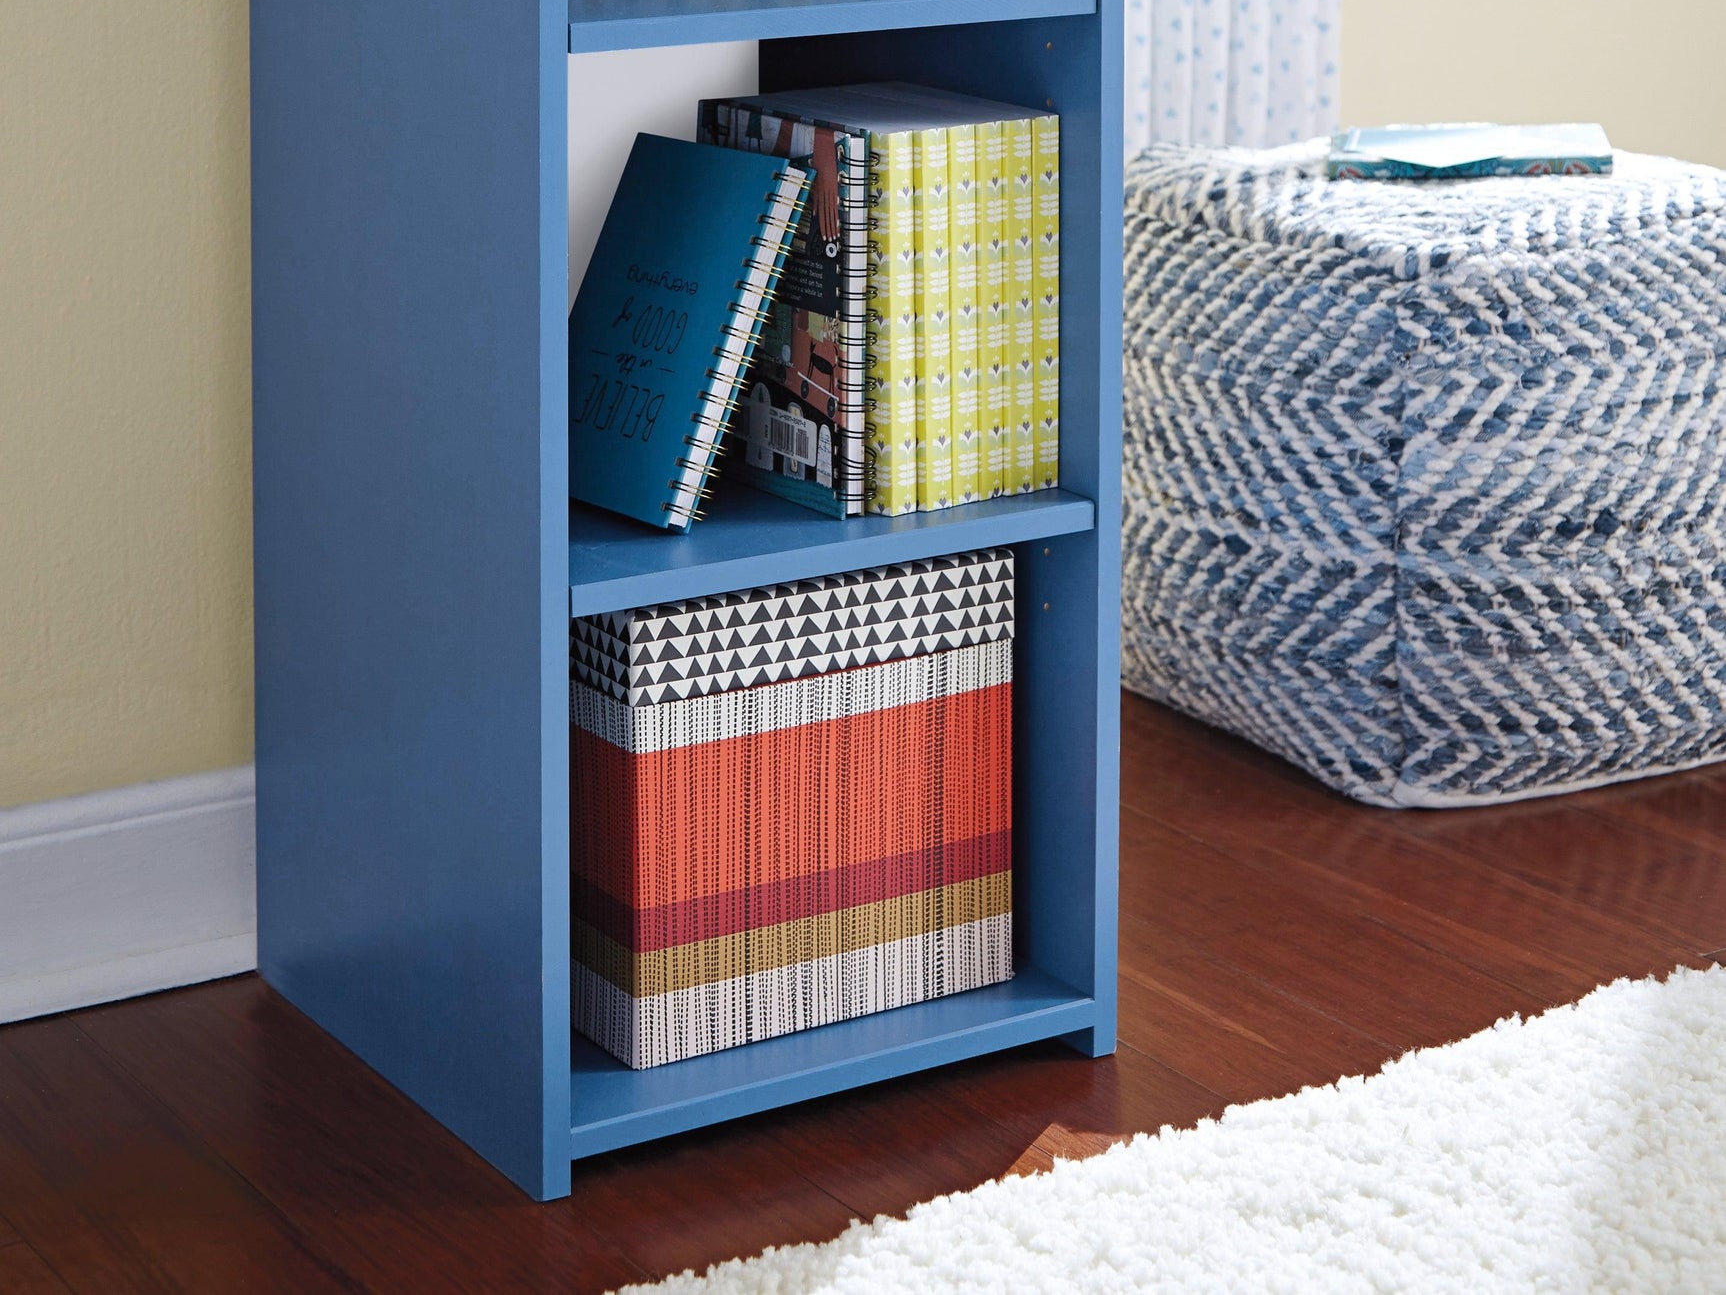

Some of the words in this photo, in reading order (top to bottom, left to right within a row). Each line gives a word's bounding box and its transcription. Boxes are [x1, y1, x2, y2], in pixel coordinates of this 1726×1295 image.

[627, 264, 699, 295] everything
[611, 296, 635, 328] of
[632, 305, 689, 354] GOOD
[615, 353, 637, 374] the
[572, 373, 665, 442] BELIEVE
